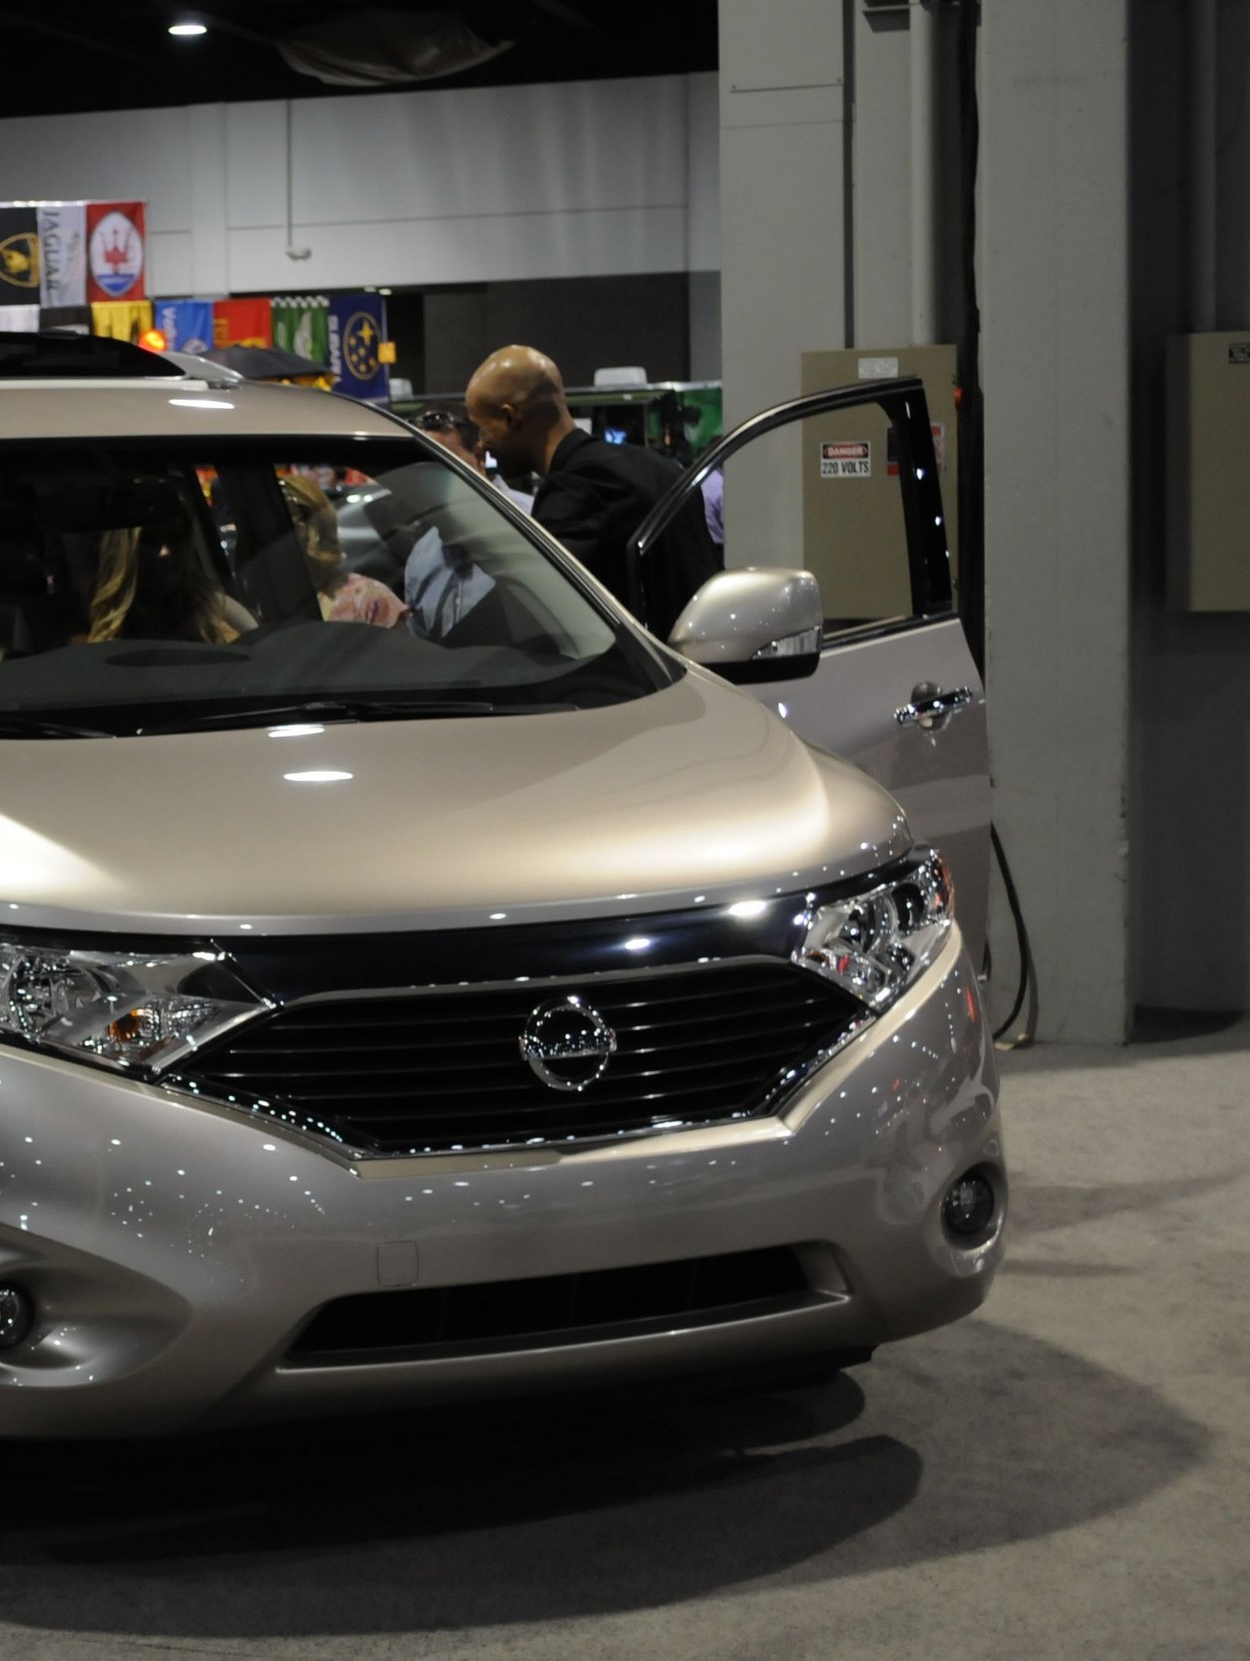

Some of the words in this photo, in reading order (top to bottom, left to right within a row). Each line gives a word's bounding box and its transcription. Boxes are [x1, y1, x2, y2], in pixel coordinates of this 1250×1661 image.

[827, 446, 864, 457] DANGER
[822, 461, 839, 475] 220
[841, 461, 869, 474] VOLTS
